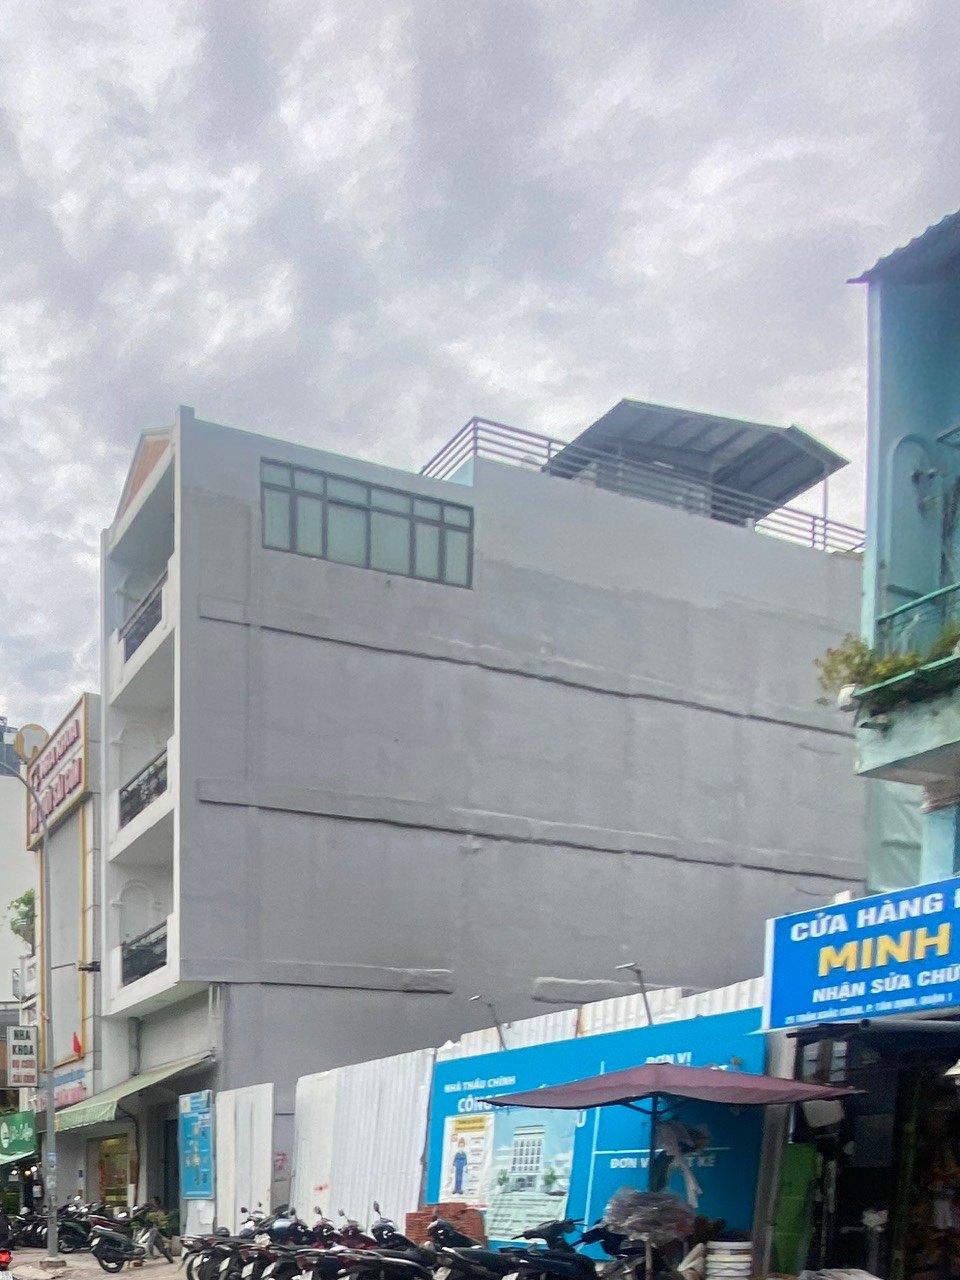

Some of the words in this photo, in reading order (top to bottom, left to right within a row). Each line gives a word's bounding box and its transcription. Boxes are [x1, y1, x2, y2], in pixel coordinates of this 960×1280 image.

[791, 912, 848, 941] CỬA
[856, 892, 943, 928] HÀNG
[818, 922, 951, 977] MINH
[812, 981, 866, 1003] NHẬN
[870, 971, 912, 994] SỬA
